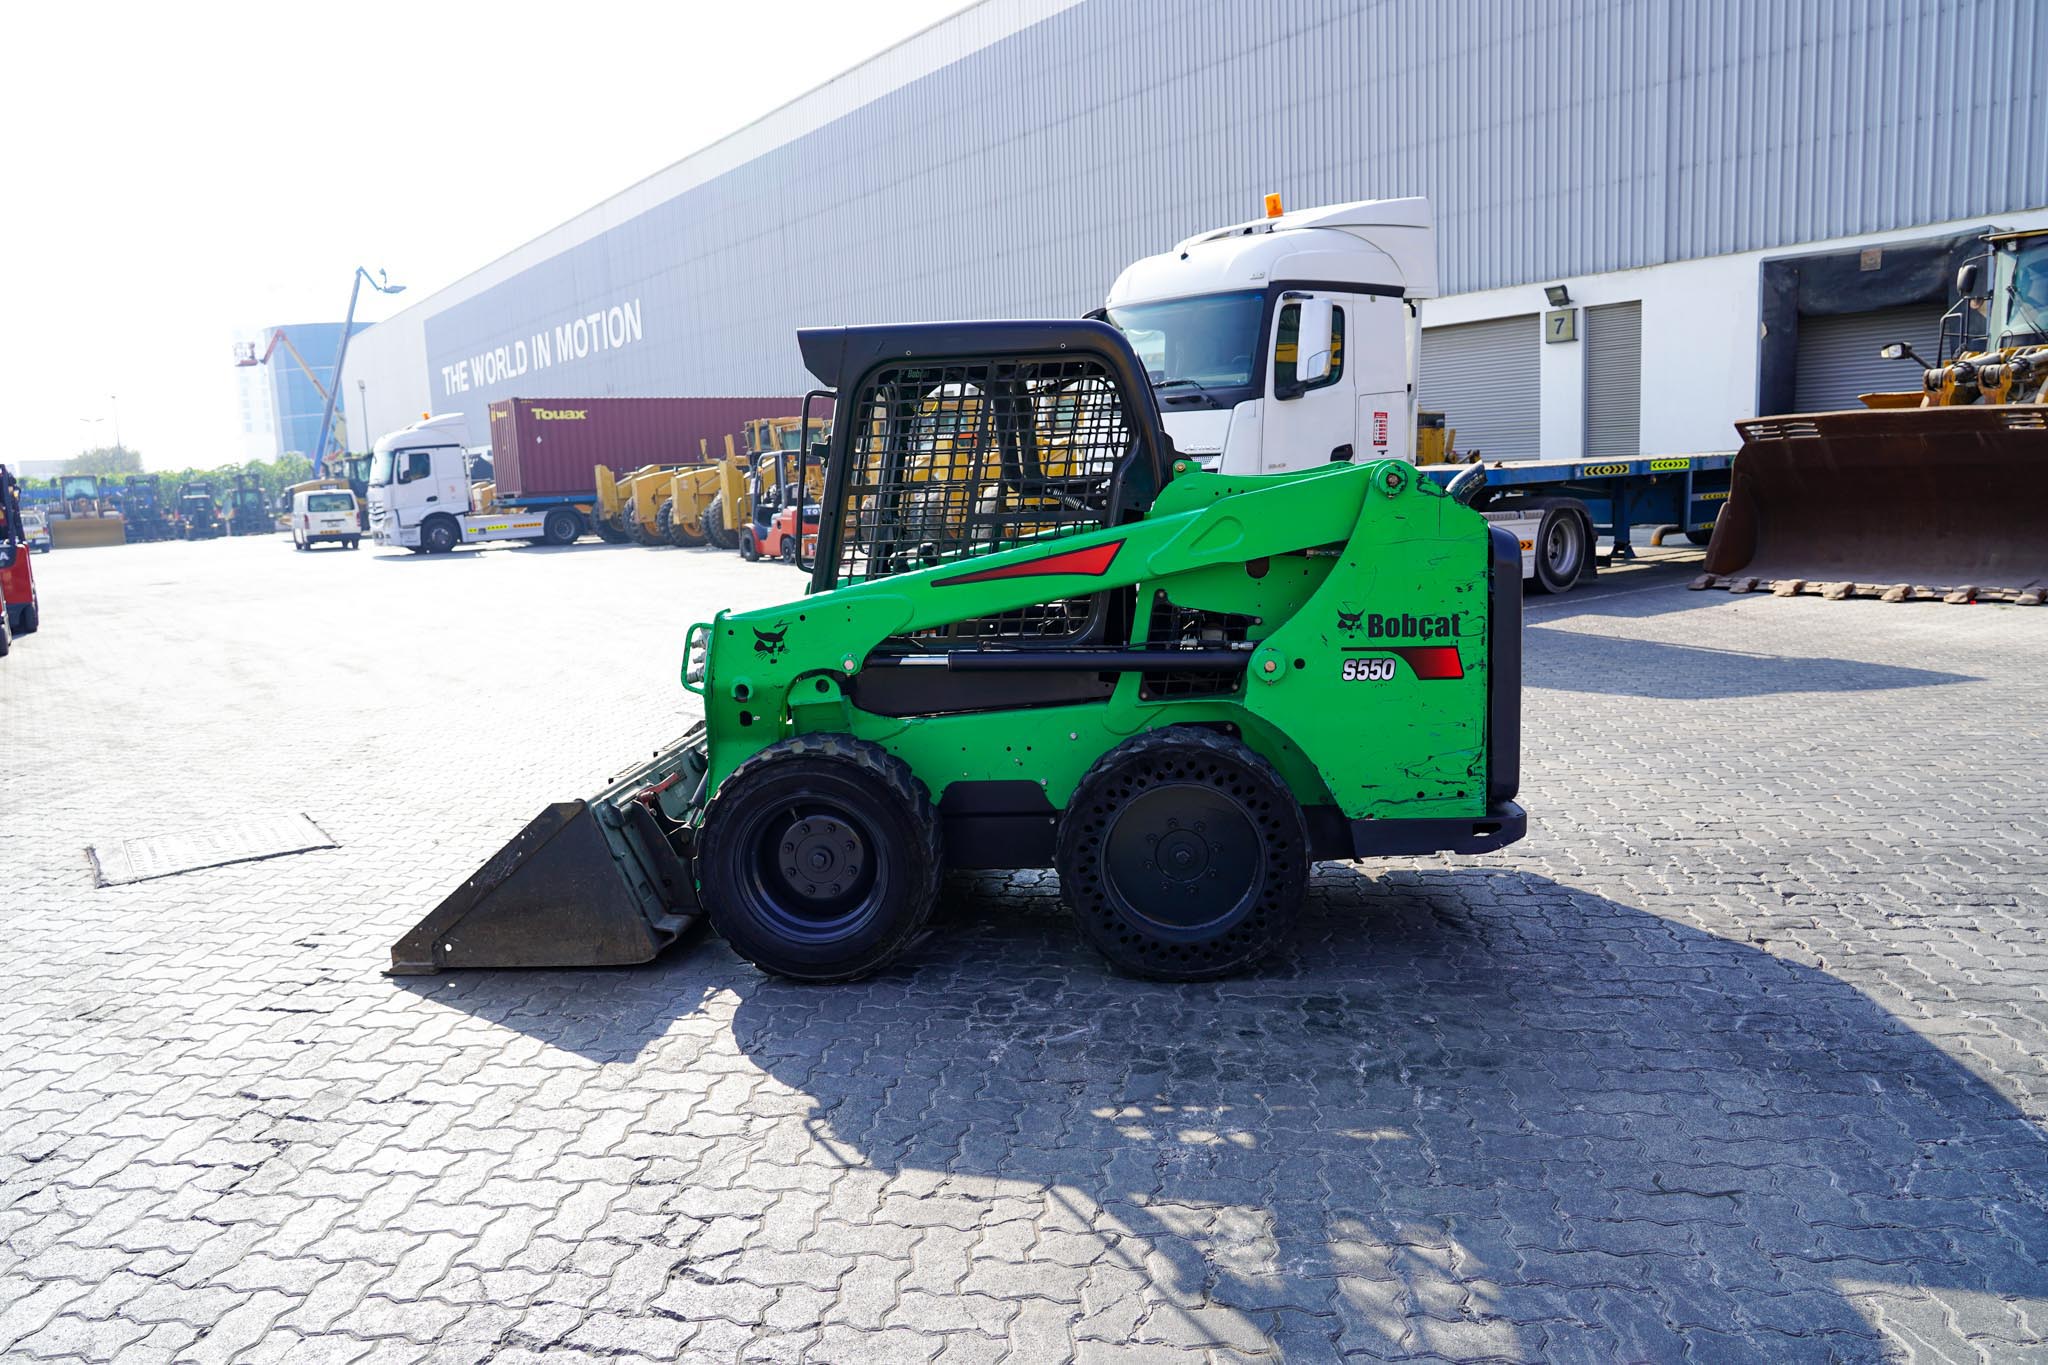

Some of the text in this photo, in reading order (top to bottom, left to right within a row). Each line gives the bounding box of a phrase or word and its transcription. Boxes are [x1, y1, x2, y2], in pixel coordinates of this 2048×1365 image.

[1554, 317, 1565, 335] 7
[442, 298, 642, 395] THE WORLD IN MOTION
[531, 408, 586, 420] Touax
[1367, 613, 1461, 638] Bobcat
[1342, 657, 1396, 681] S550
